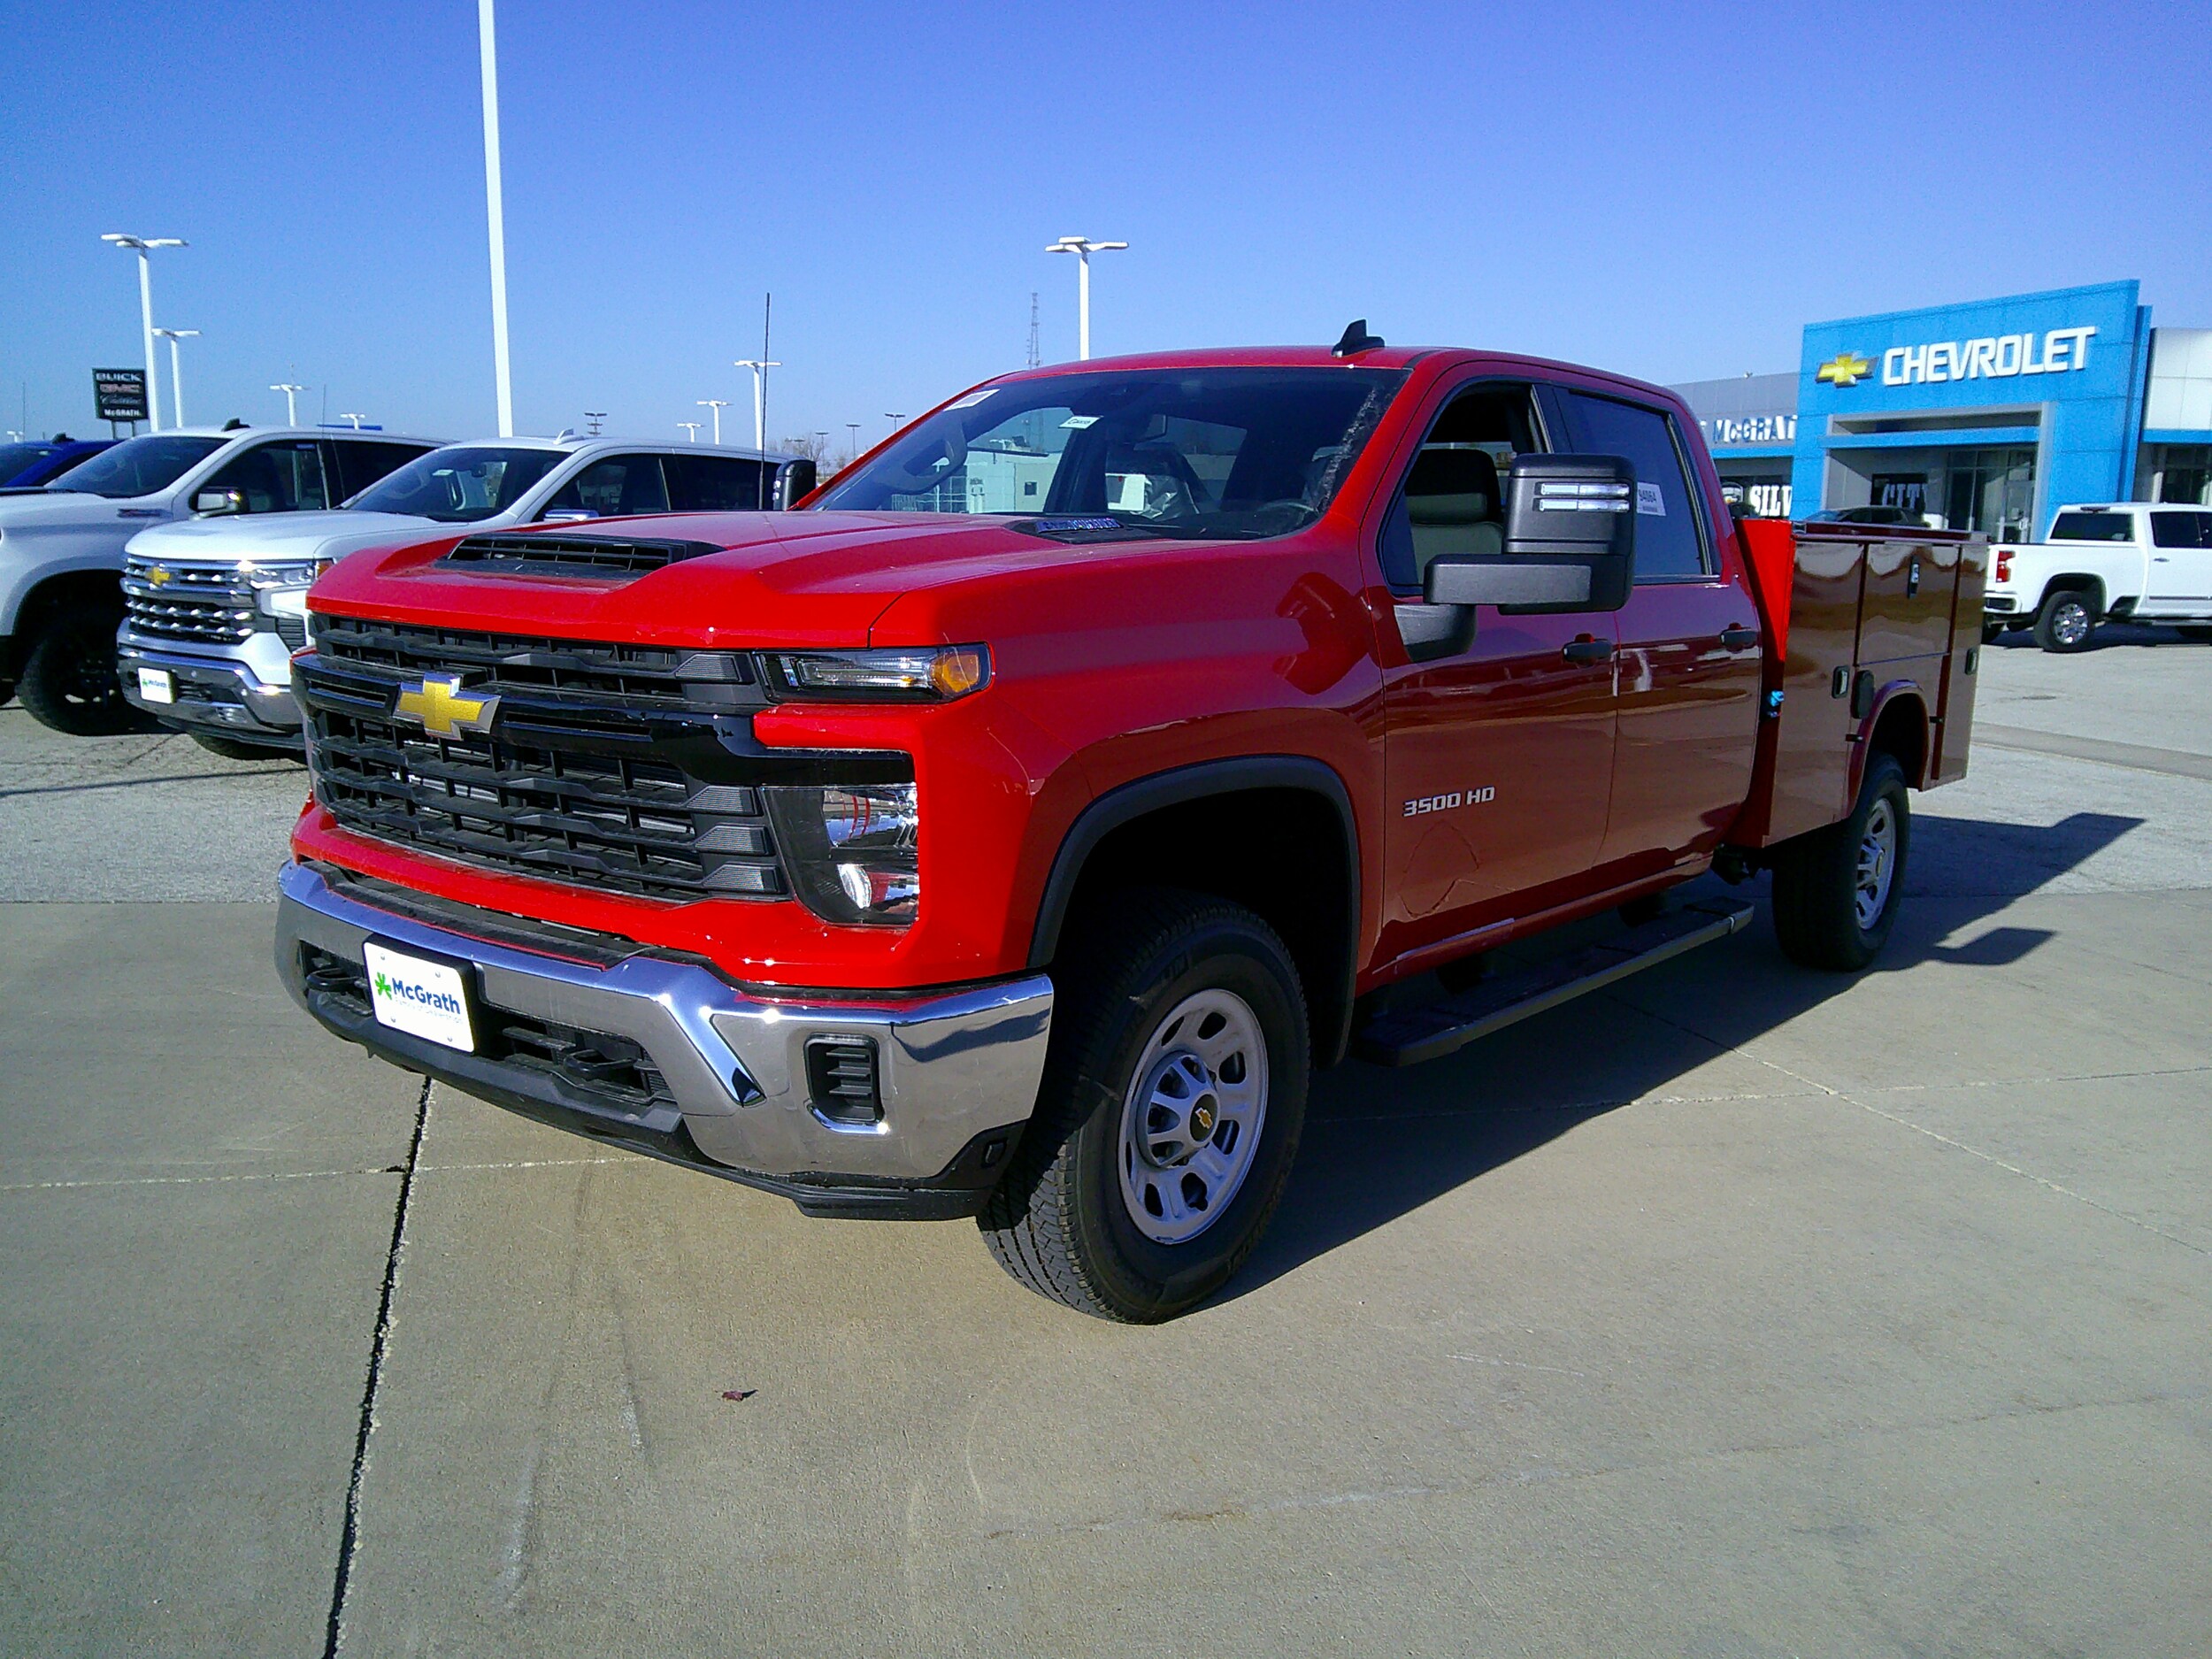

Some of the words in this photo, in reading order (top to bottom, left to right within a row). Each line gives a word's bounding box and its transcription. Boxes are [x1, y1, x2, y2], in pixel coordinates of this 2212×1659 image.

[1883, 326, 2097, 386] CHEVROLET
[96, 373, 143, 382] BUICK
[1402, 792, 1462, 818] 3500
[1465, 786, 1495, 806] HD
[391, 976, 461, 1015] McGrath
